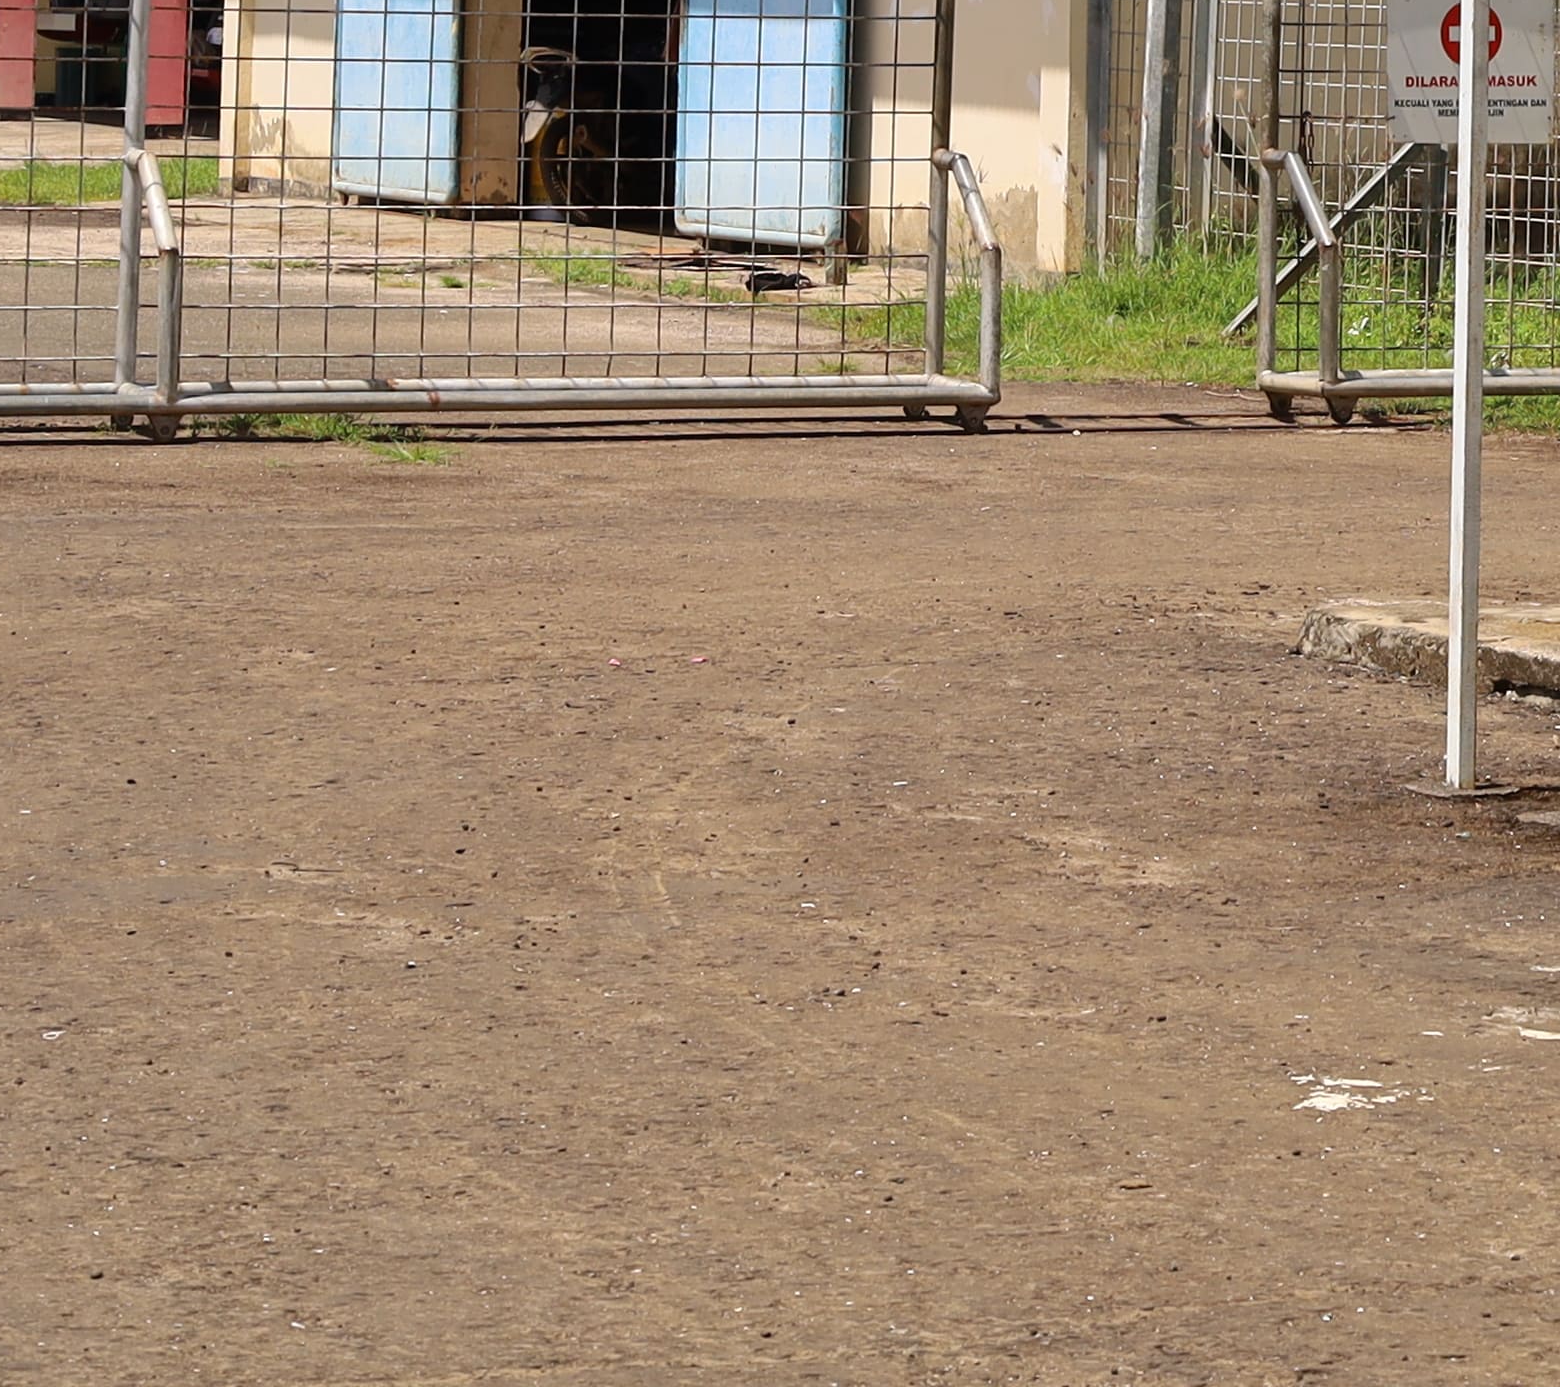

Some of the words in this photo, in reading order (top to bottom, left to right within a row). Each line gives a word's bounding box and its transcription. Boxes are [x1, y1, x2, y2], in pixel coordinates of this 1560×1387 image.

[1405, 76, 1458, 87] DILARA
[1488, 75, 1537, 87] MASUK
[1394, 99, 1429, 107] KECUALI
[1432, 99, 1453, 107] YANG
[1531, 99, 1546, 107] DAN
